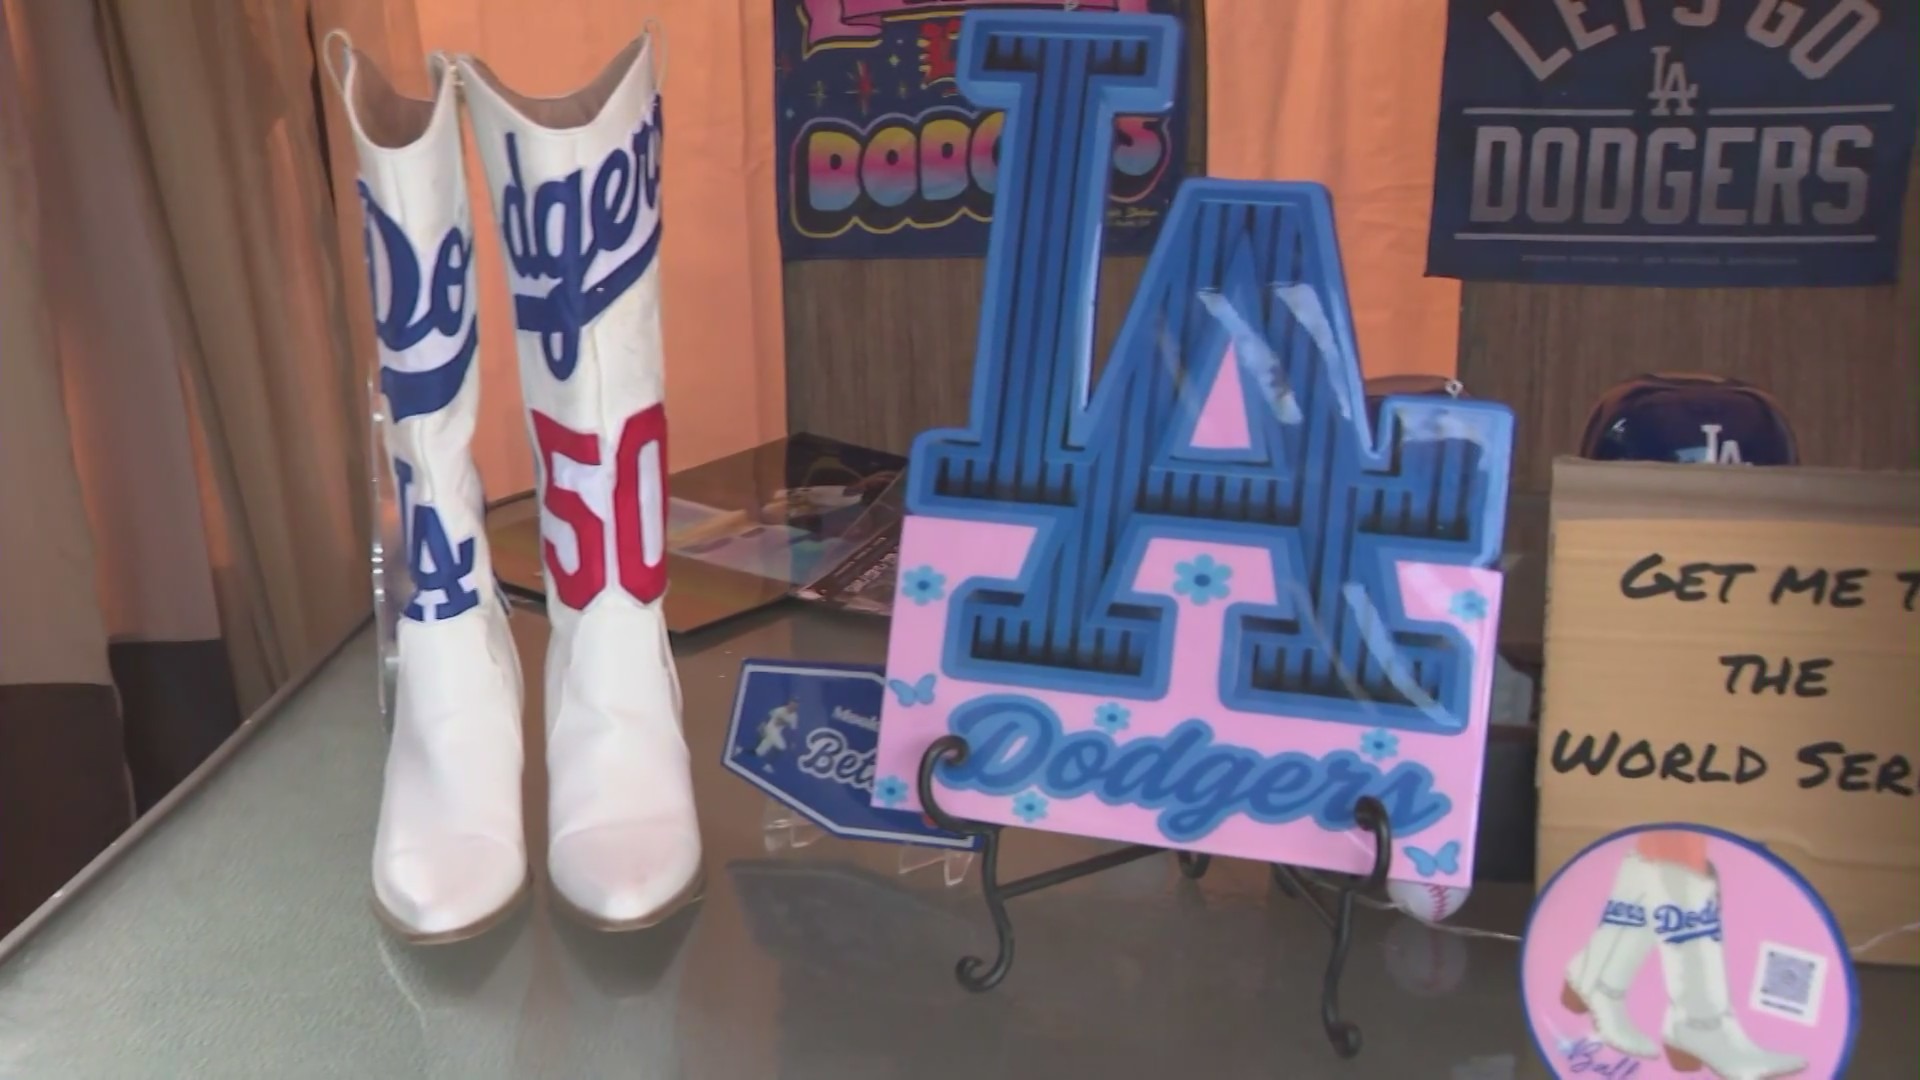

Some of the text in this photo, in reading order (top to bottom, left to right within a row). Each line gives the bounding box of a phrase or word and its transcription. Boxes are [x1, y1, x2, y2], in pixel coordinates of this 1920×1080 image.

[1648, 46, 1698, 116] LA
[1469, 124, 1874, 225] DODGERS
[905, 10, 1515, 736] LA
[531, 402, 668, 611] 50
[1621, 553, 1757, 604] GET
[1770, 565, 1870, 608] ME
[1719, 654, 1833, 697] THE
[798, 727, 877, 794] Bet
[935, 693, 1452, 842] Dodgers
[1550, 729, 1920, 796] WORLD SER
